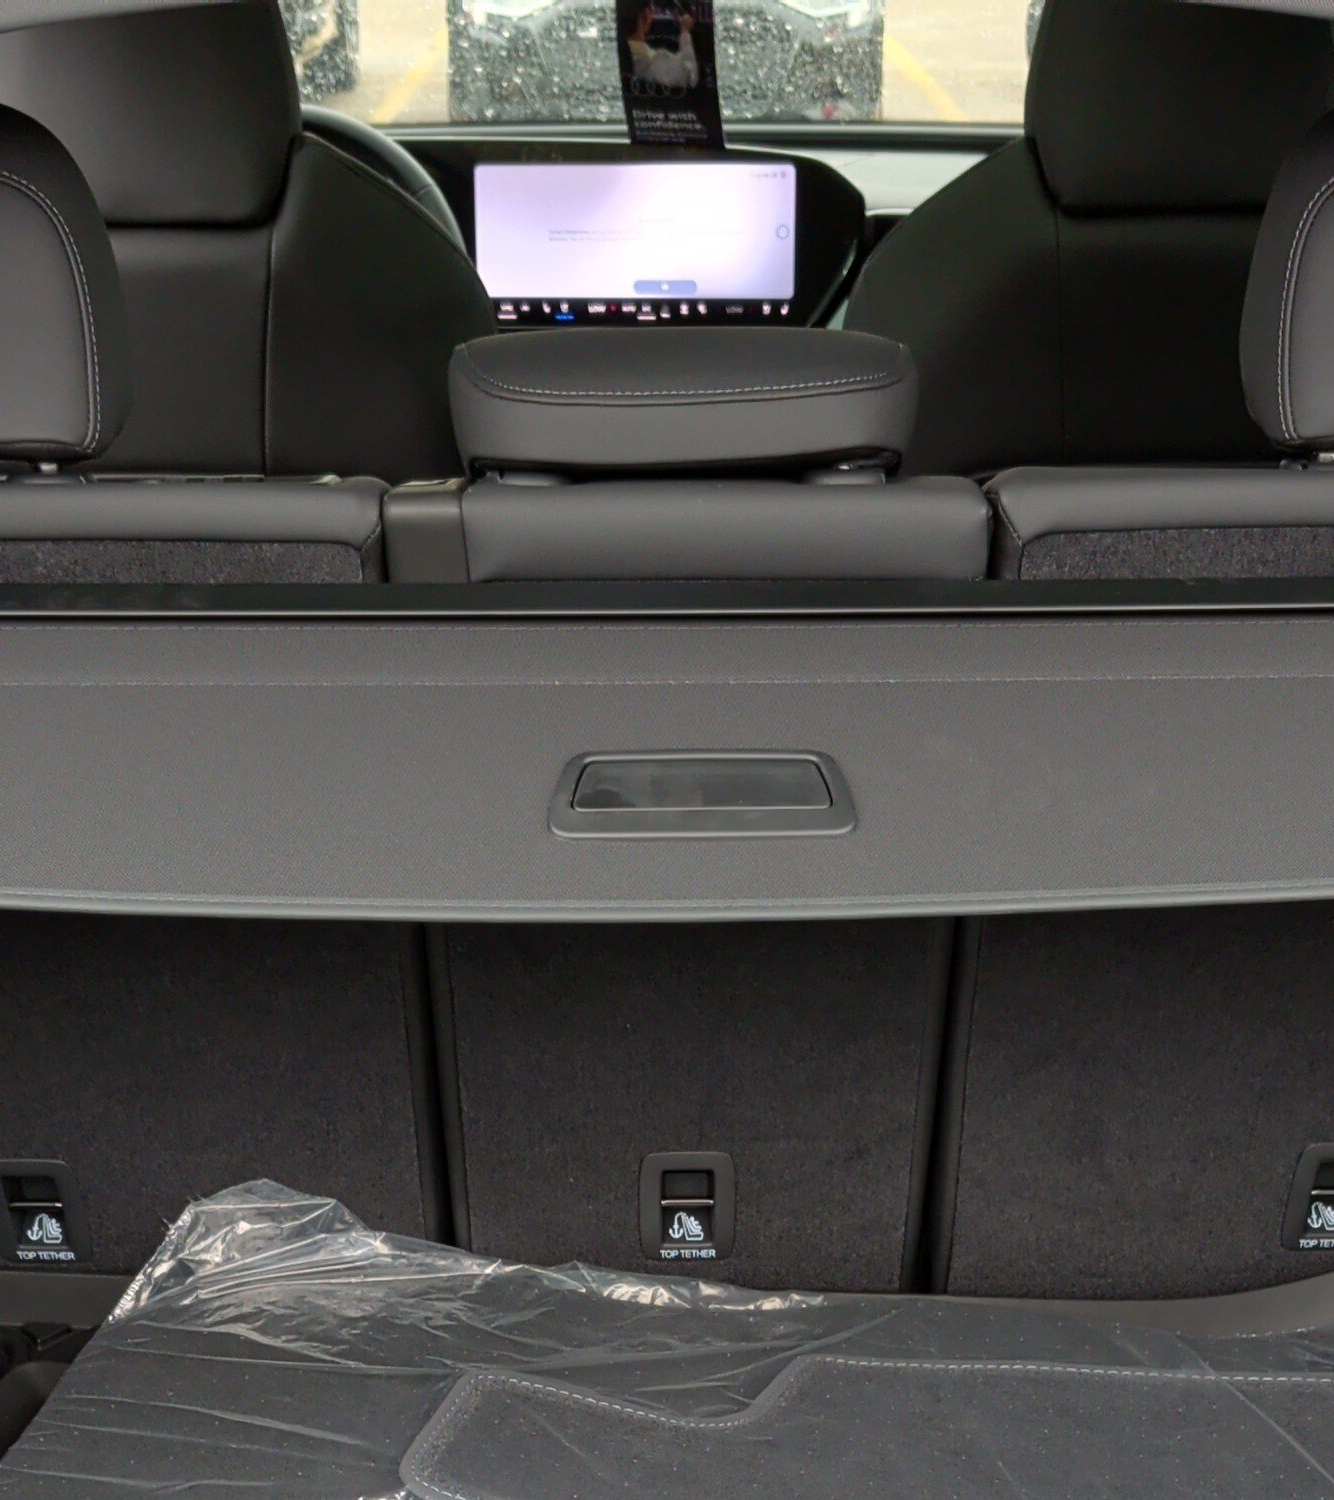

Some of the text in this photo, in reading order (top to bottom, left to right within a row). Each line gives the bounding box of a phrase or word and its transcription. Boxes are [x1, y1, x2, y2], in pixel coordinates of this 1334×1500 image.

[1298, 1238, 1319, 1248] TOP
[16, 1250, 76, 1260] TOP TETHER
[659, 1248, 716, 1259] TOP TETHER
